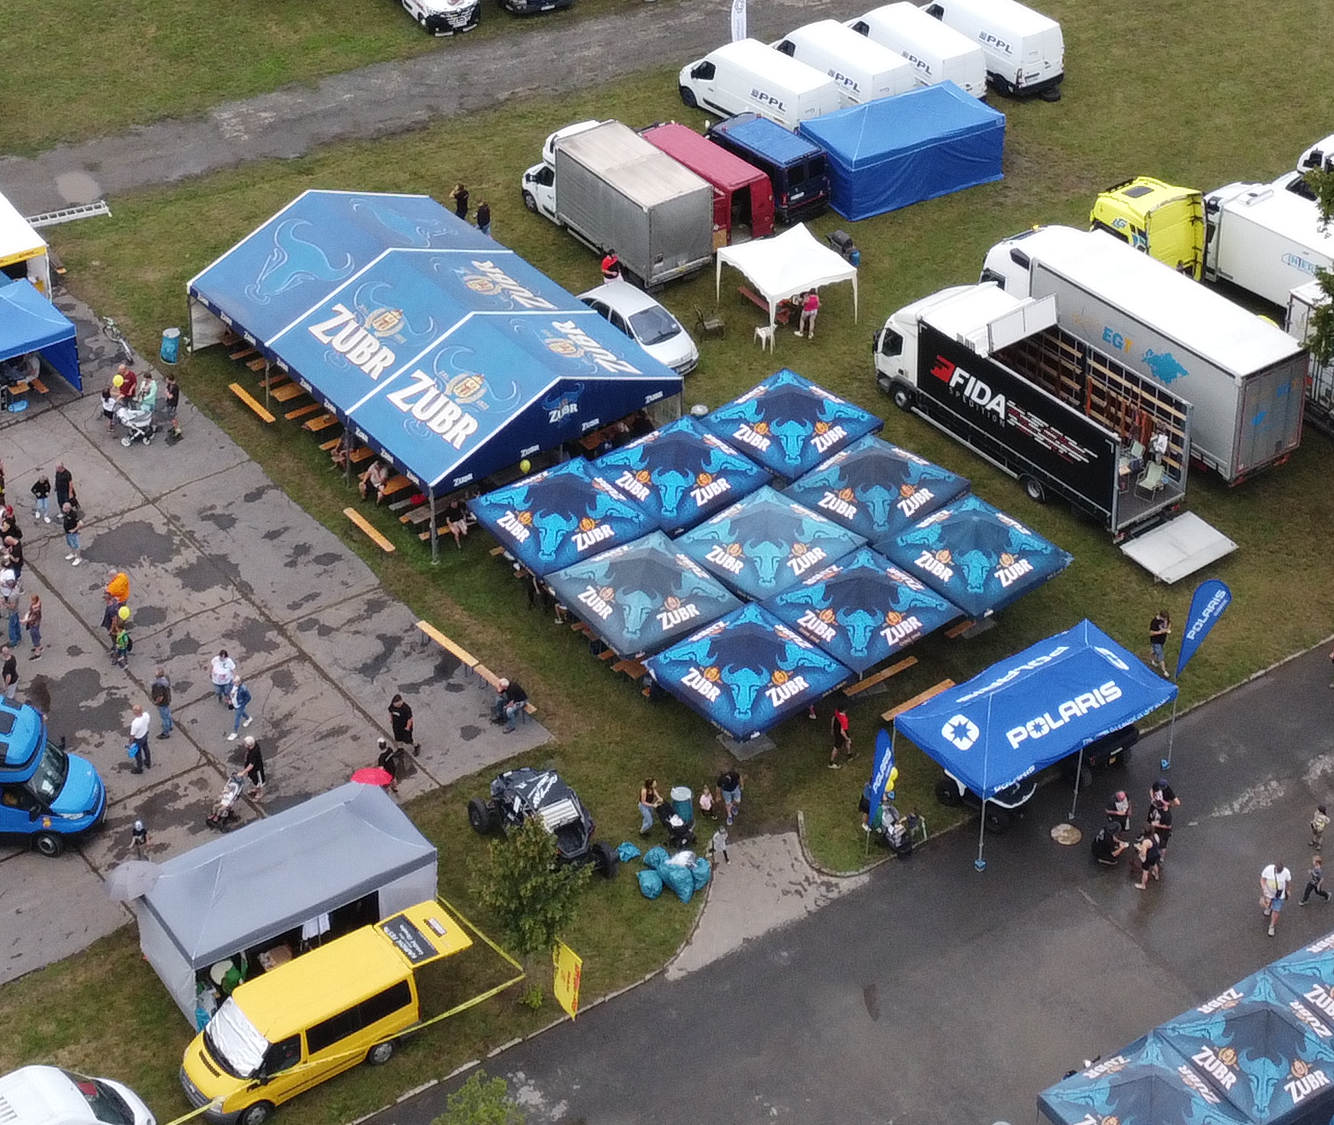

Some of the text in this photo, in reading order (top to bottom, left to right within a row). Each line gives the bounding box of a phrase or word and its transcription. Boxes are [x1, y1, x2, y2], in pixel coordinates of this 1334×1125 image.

[984, 35, 1013, 55] PPL
[908, 55, 932, 76] PPL
[834, 73, 860, 93] PPL
[758, 92, 786, 112] PPL
[308, 303, 396, 381] ZUBR
[1102, 327, 1134, 354] EGT
[949, 366, 1006, 420] FIDA
[387, 369, 479, 451] ZUBR
[548, 403, 578, 424] ZUBR
[734, 424, 771, 453] ZUBR
[810, 425, 848, 453] ZUBR
[615, 470, 650, 502] ZUBR
[690, 477, 732, 507] ZUBR
[817, 491, 857, 520] ZUBR
[897, 488, 934, 518] ZUBR
[497, 510, 531, 543] ZUBR
[572, 524, 615, 552] ZUBR
[705, 542, 744, 574] ZUBR
[786, 546, 826, 576] ZUBR
[914, 550, 954, 582] ZUBR
[994, 558, 1034, 588] ZUBR
[578, 585, 613, 620] ZUBR
[657, 603, 700, 631] ZUBR
[1186, 589, 1226, 640] POLARIS
[797, 610, 836, 643] ZUBR
[880, 615, 923, 647] ZUBR
[681, 667, 721, 702] ZUBR
[765, 675, 809, 708] ZUBR
[1006, 680, 1123, 750] POLARIS
[1192, 1045, 1238, 1090] ZUBR
[1284, 1070, 1330, 1105] ZUBR
